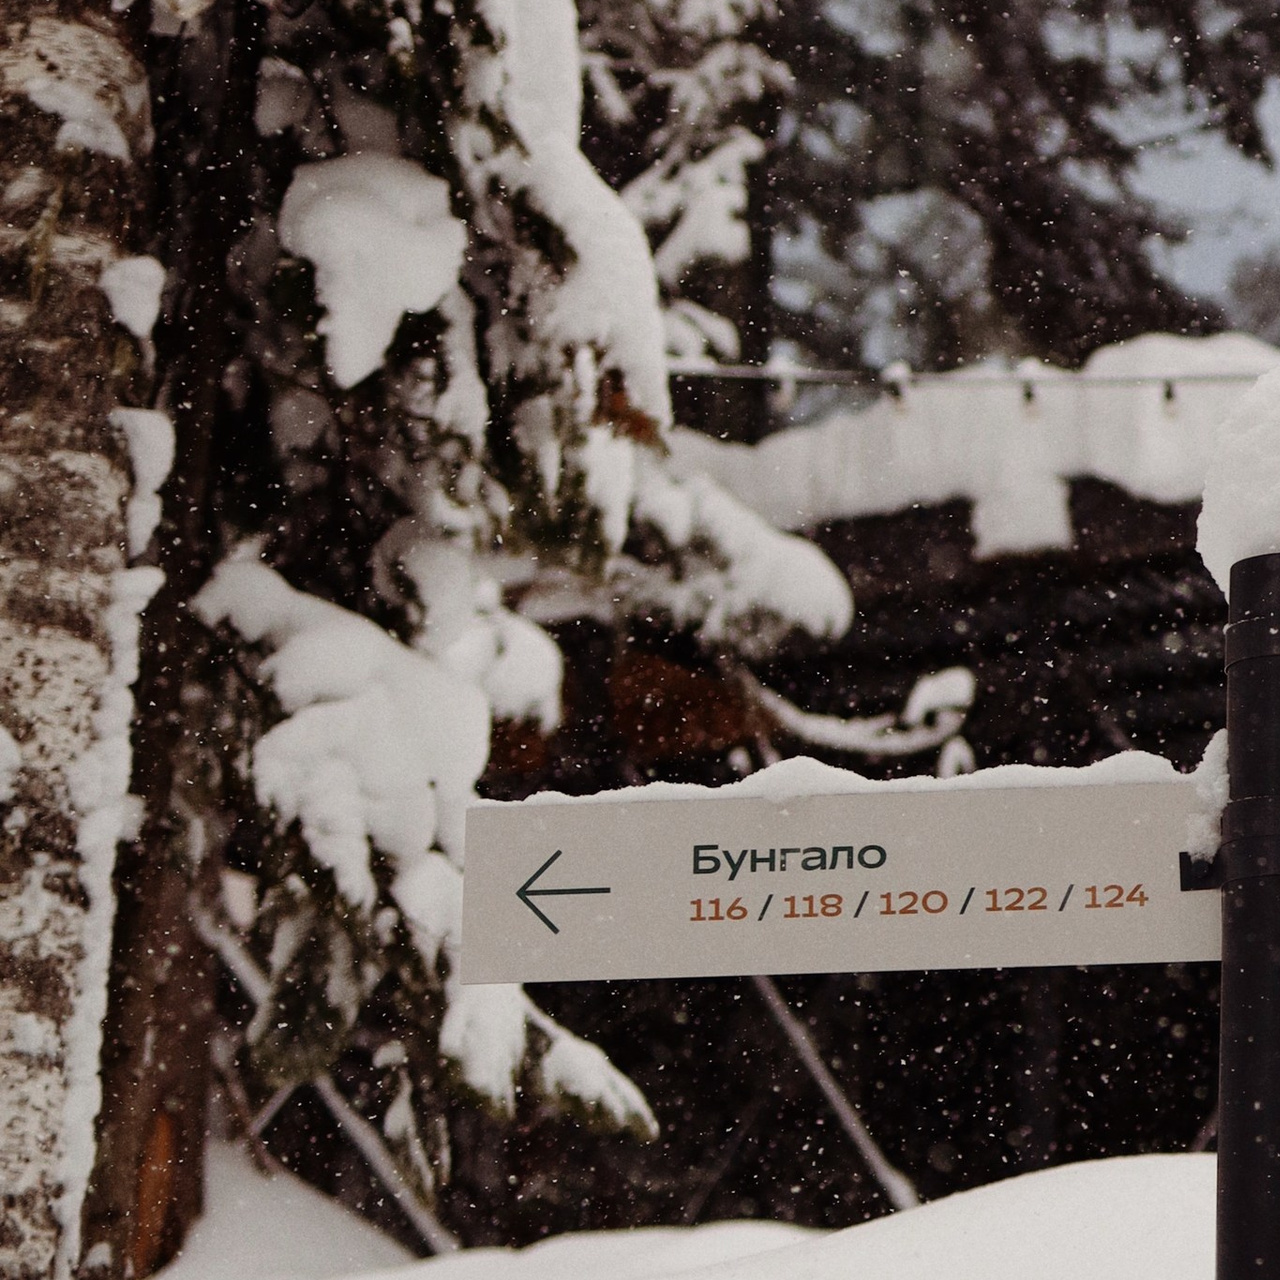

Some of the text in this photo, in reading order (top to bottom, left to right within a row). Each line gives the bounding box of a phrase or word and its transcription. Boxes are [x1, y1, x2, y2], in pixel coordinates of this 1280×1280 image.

[692, 844, 888, 882] Бунгало
[689, 896, 749, 922] 116
[783, 893, 844, 919] 118
[879, 889, 949, 916] 120
[985, 886, 1048, 912] 122
[1084, 883, 1150, 909] 124
